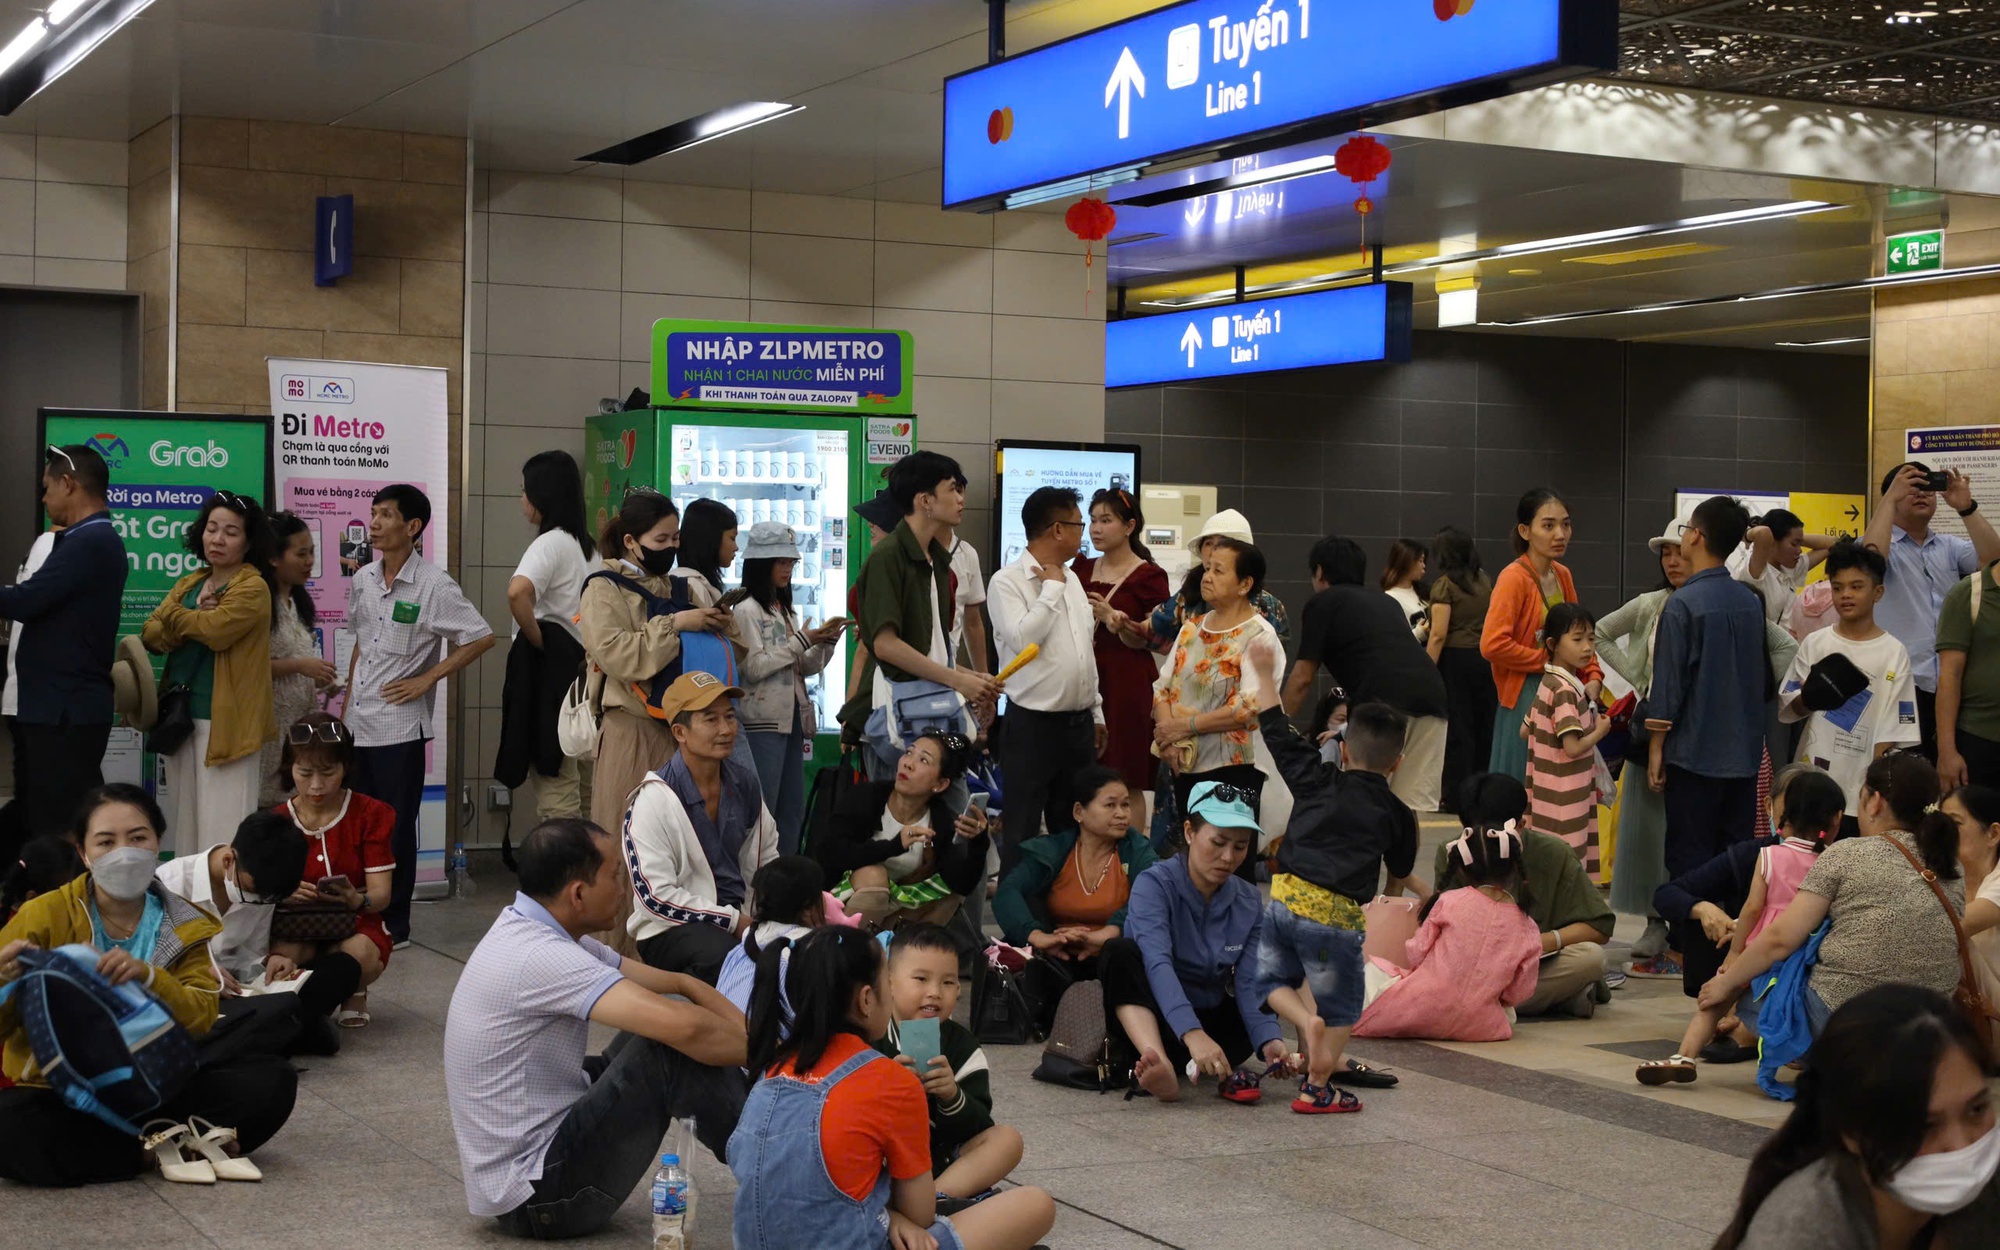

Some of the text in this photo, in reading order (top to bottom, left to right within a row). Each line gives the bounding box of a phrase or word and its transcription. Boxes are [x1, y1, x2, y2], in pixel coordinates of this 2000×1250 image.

[1208, 0, 1309, 68] Tuyến 1
[1206, 70, 1261, 117] Line 1
[1921, 242, 1939, 253] EXIT
[1232, 308, 1280, 342] Tuyến 1
[686, 336, 884, 365] NHẬP ZLPMETRO
[1231, 343, 1259, 363] Line 1
[683, 362, 884, 384] NHẬN 1 CHAI NƯỚC MIỄN PHÍ
[705, 388, 853, 404] KHI THANH TOÁN QUA ZALOPAY
[281, 412, 385, 440] Đi Metro
[149, 439, 229, 468] Grab
[282, 440, 390, 456] Chạm là qua cổng với
[869, 443, 911, 455] EVEND
[282, 455, 389, 468] QR thanh toán MoMo
[131, 491, 152, 507] ga
[155, 490, 203, 505] Metro
[294, 486, 315, 496] Mua
[316, 486, 329, 496] vé
[329, 485, 353, 499] bằng
[354, 489, 360, 497] 2
